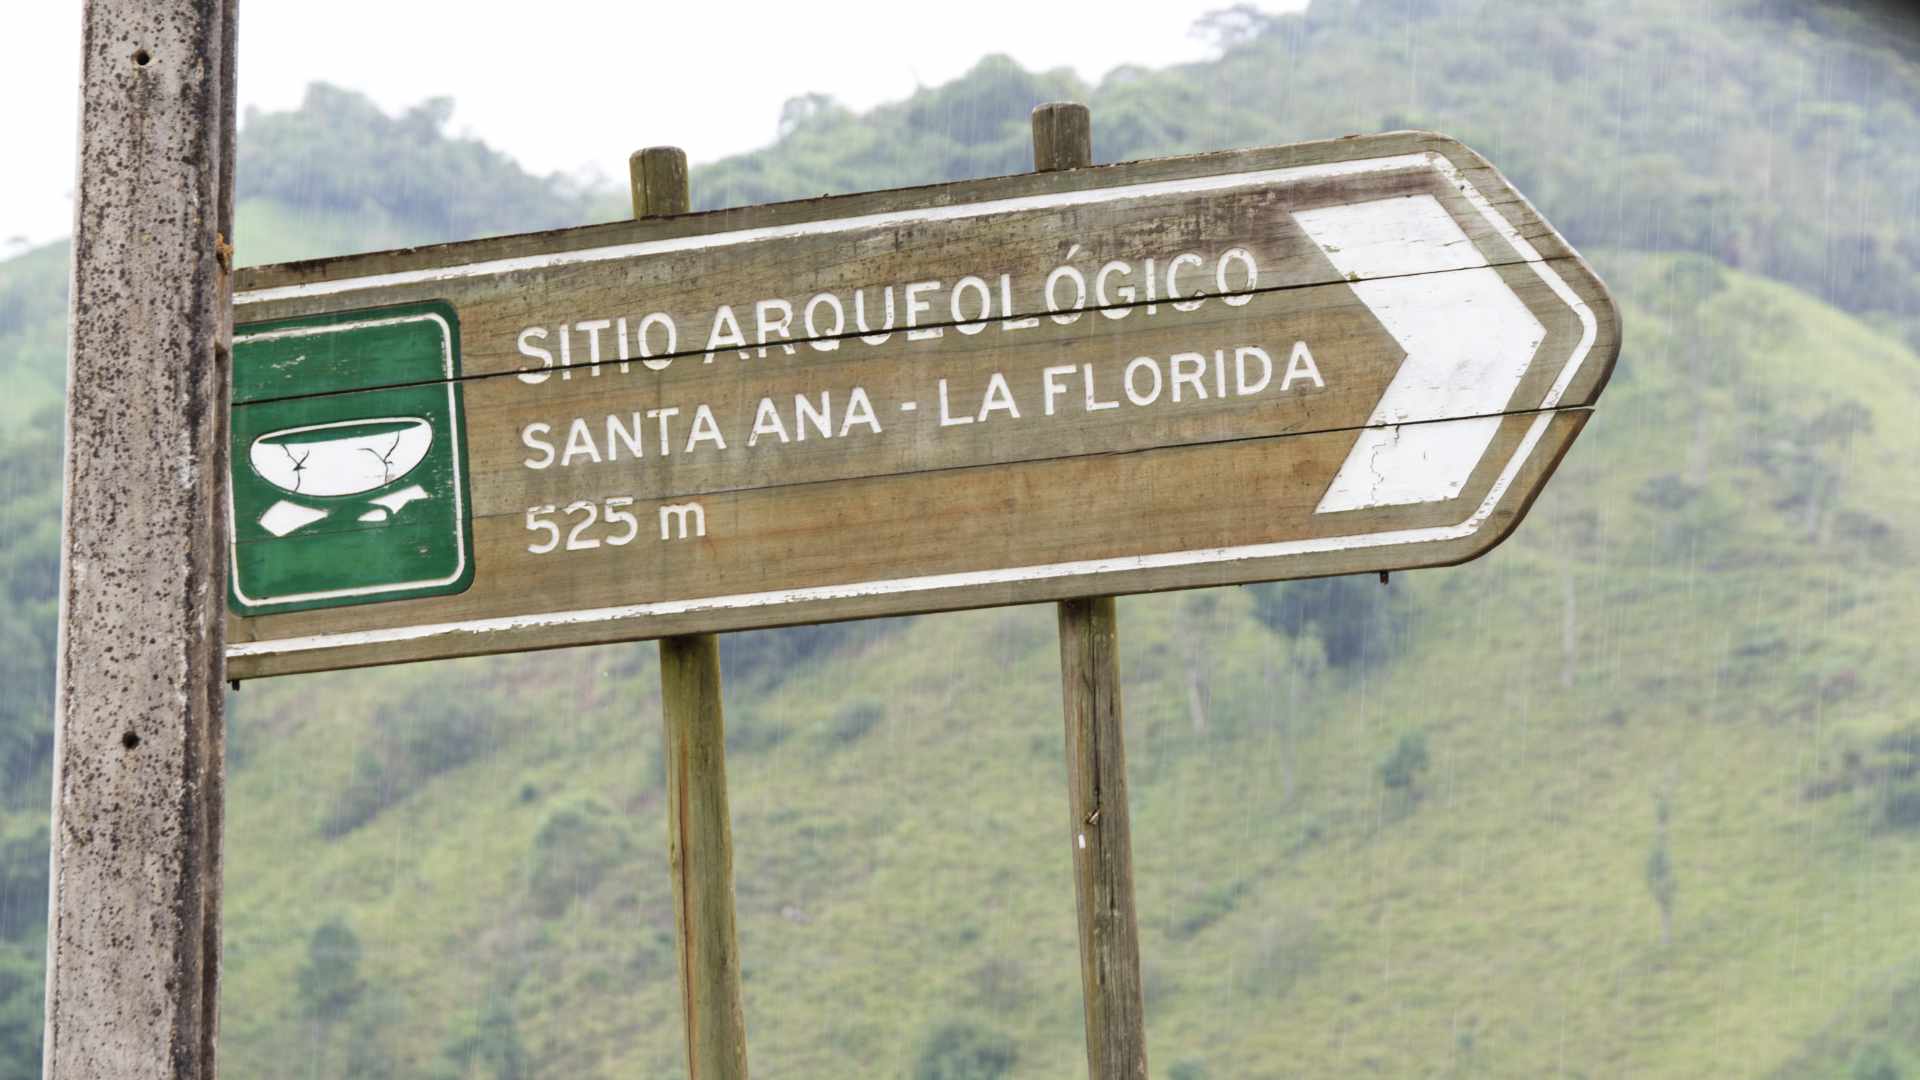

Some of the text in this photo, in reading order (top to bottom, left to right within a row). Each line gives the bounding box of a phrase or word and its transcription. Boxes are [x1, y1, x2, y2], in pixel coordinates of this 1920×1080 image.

[516, 244, 1258, 385] SITIO ARQUEOLÓGICO
[521, 341, 1325, 469] SANTA ANA - LA FLORIDA
[526, 496, 706, 554] 525 m
